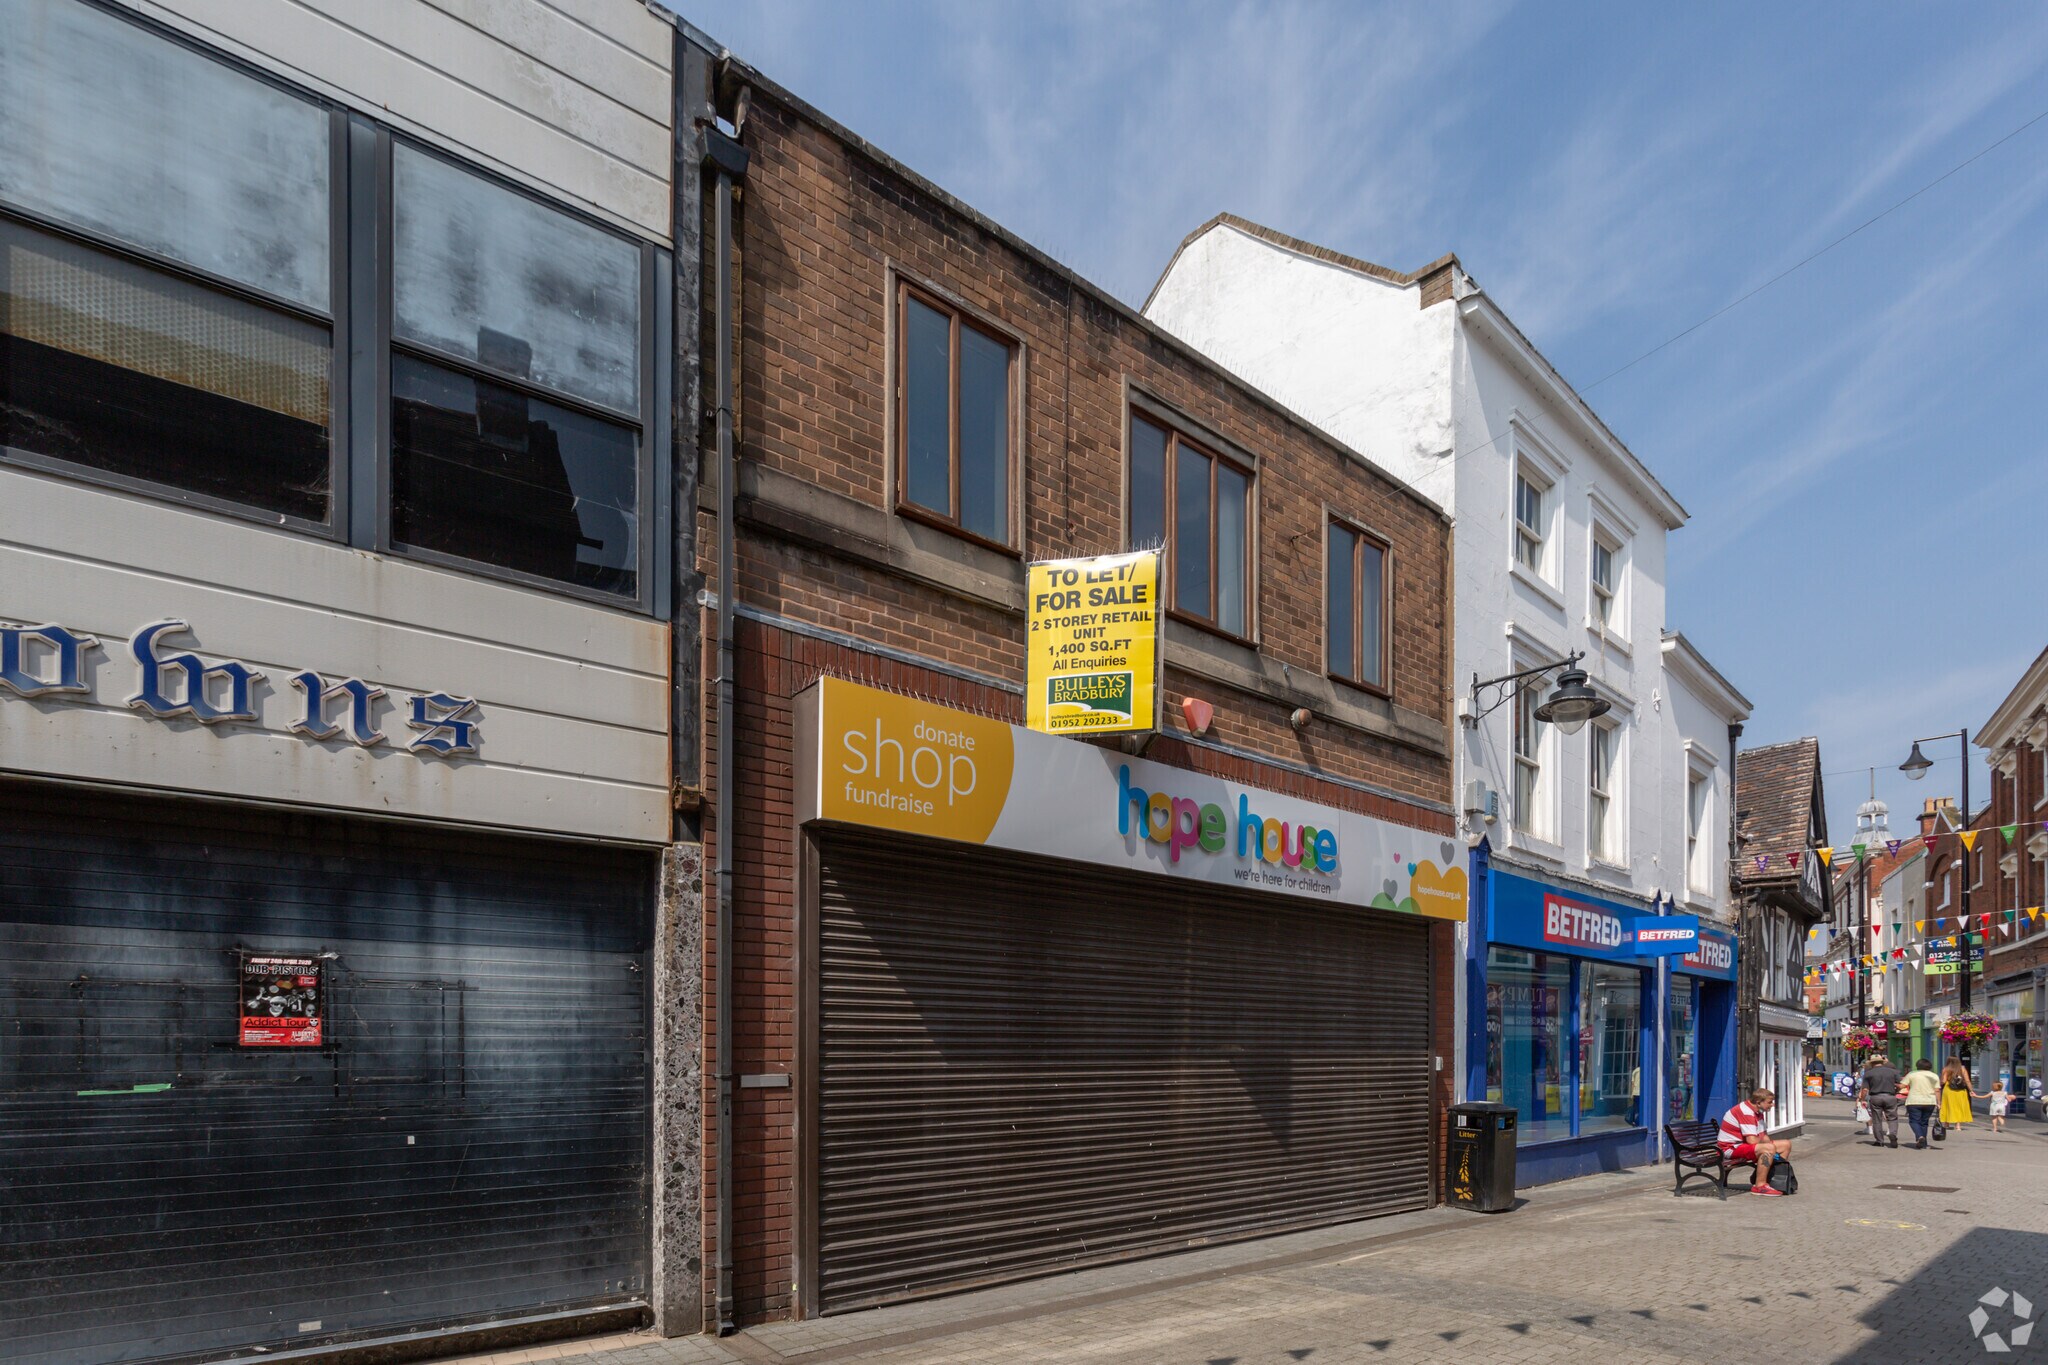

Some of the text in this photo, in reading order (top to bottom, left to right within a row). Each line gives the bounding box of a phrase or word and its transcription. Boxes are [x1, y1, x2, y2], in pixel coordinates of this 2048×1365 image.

[1047, 562, 1137, 588] TO LET/
[1036, 584, 1147, 613] FOR SALE
[1031, 610, 1152, 631] 2 STOREY RETAIL
[1073, 626, 1106, 640] UNIT
[1048, 638, 1132, 657] 1,400 SQ.FT
[1053, 655, 1127, 671] All Enquiries
[1054, 674, 1126, 692] BULLEYS
[1054, 687, 1125, 703] BRADBURY
[1051, 711, 1101, 720] bulleysbradbury.co.uk
[1051, 716, 1118, 728] 01952 292233
[913, 719, 976, 751] donate
[842, 717, 977, 807] shop
[844, 781, 934, 816] fundraise
[1118, 764, 1338, 873] hope house
[1234, 868, 1331, 894] we're here for children
[1547, 902, 1622, 947] BETFRED
[1638, 929, 1695, 941] BETFRED
[245, 964, 318, 975] DUB PISTOLS
[1936, 963, 1976, 972] TO LT
[245, 1017, 309, 1027] Addict Tour
[1459, 1130, 1476, 1139] Litter
